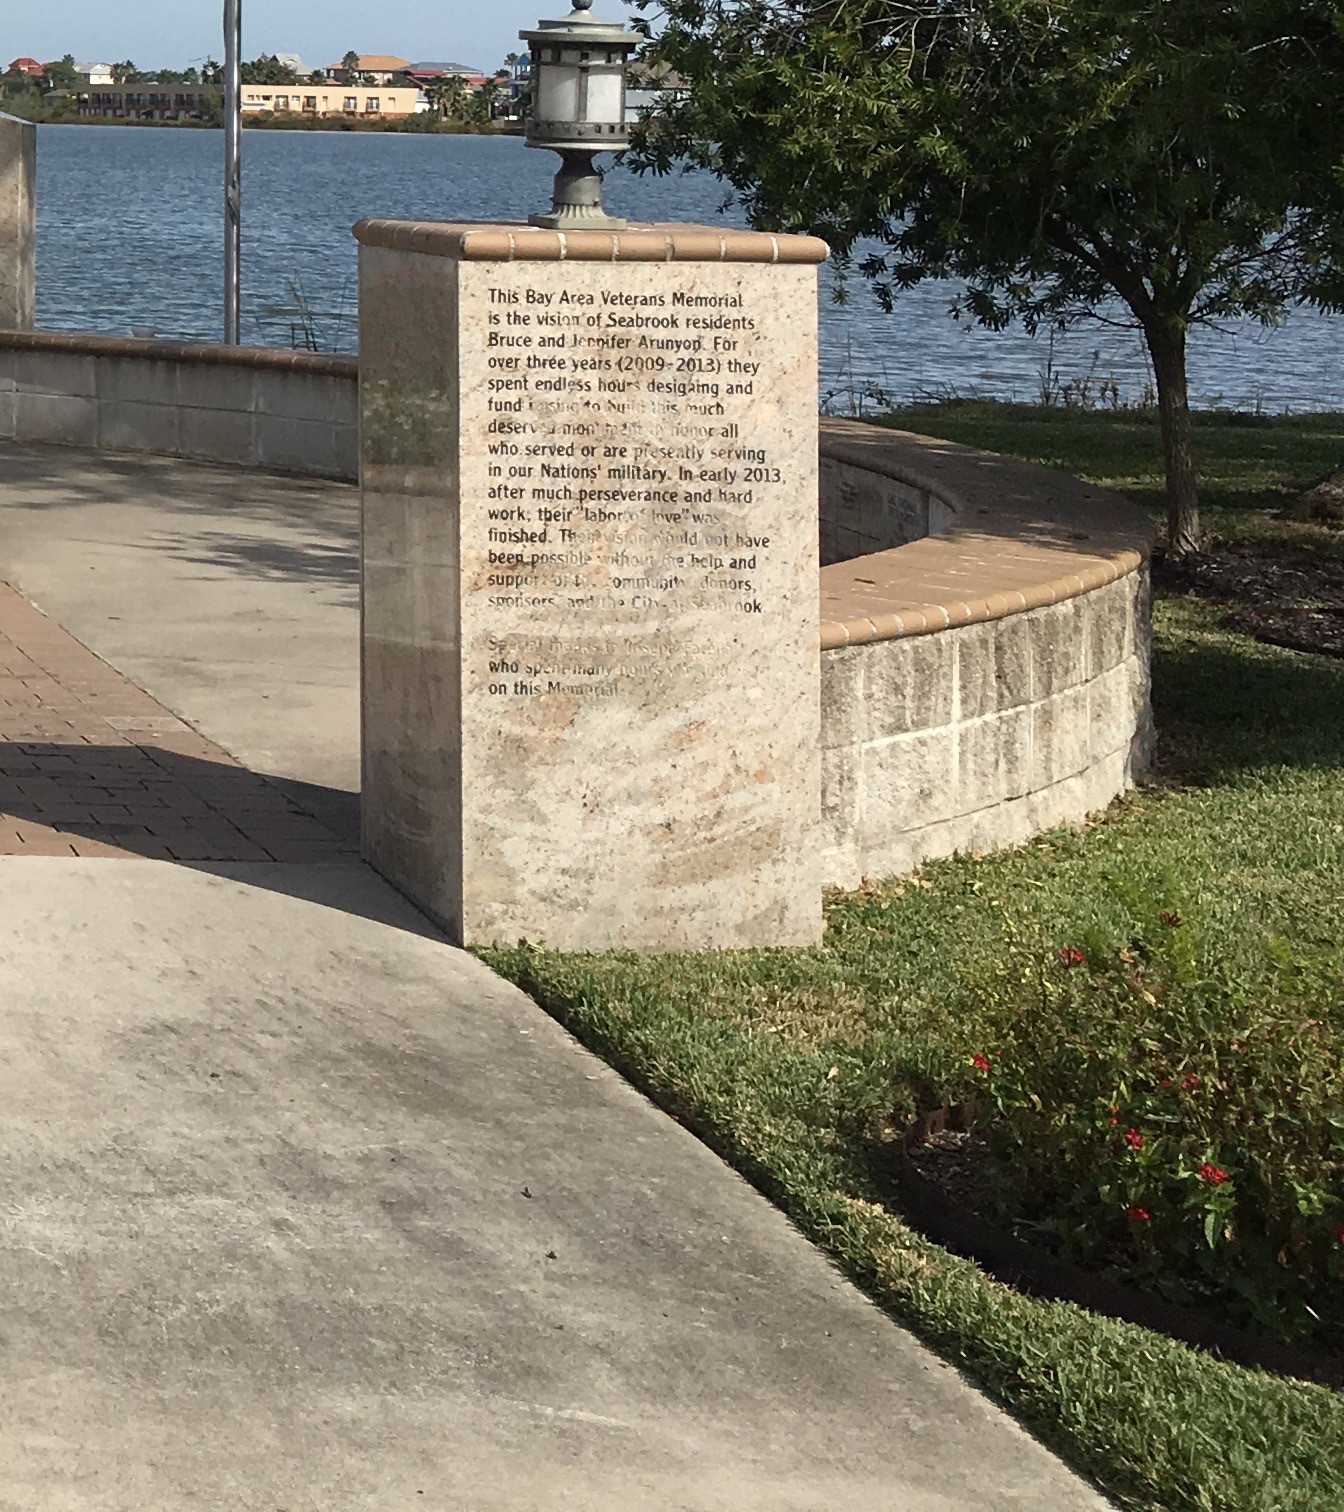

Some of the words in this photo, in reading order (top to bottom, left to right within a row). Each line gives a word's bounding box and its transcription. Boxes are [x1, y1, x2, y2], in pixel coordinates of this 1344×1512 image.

[488, 288, 519, 304] This
[526, 289, 555, 307] Bay
[560, 290, 594, 305] Area
[601, 291, 665, 307] Veterans
[672, 291, 743, 308] Memorial
[488, 312, 500, 325] is
[506, 311, 531, 326] the
[536, 313, 580, 327] vision
[587, 312, 602, 328] of
[608, 312, 679, 329] Seabrook
[685, 315, 755, 330] residents
[488, 332, 532, 347] Bruce
[538, 333, 565, 348] and
[571, 333, 631, 349] Jennifer
[713, 337, 738, 351] For
[488, 357, 520, 369] over
[526, 354, 566, 369] three
[572, 359, 612, 375] years
[727, 358, 760, 375] they
[488, 377, 528, 395] spent
[535, 378, 592, 393] endless
[726, 381, 753, 395] and
[488, 397, 522, 412] fund
[686, 401, 724, 416] much
[720, 423, 739, 438] all
[488, 441, 519, 456] who
[525, 441, 574, 457] served
[580, 445, 596, 457] or
[603, 446, 627, 458] are
[634, 443, 705, 462] presently
[710, 446, 766, 464] serving
[488, 463, 502, 476] in
[508, 466, 533, 478] our
[540, 464, 602, 479] Nations'
[607, 464, 672, 483] military.
[679, 466, 693, 480] In
[699, 467, 737, 485] early
[743, 467, 786, 485] 2013,
[488, 486, 525, 500] after
[532, 486, 572, 501] much
[579, 489, 678, 507] perseverance
[684, 489, 712, 504] and
[718, 489, 752, 505] hard
[537, 507, 573, 523] their
[692, 512, 720, 525] was
[488, 528, 552, 543] finished.
[736, 532, 770, 548] have
[488, 550, 524, 565] been
[531, 550, 593, 569] possible
[690, 553, 723, 571] help
[729, 555, 757, 570] and
[489, 660, 519, 674] who
[489, 683, 507, 695] on
[514, 681, 541, 696] this
